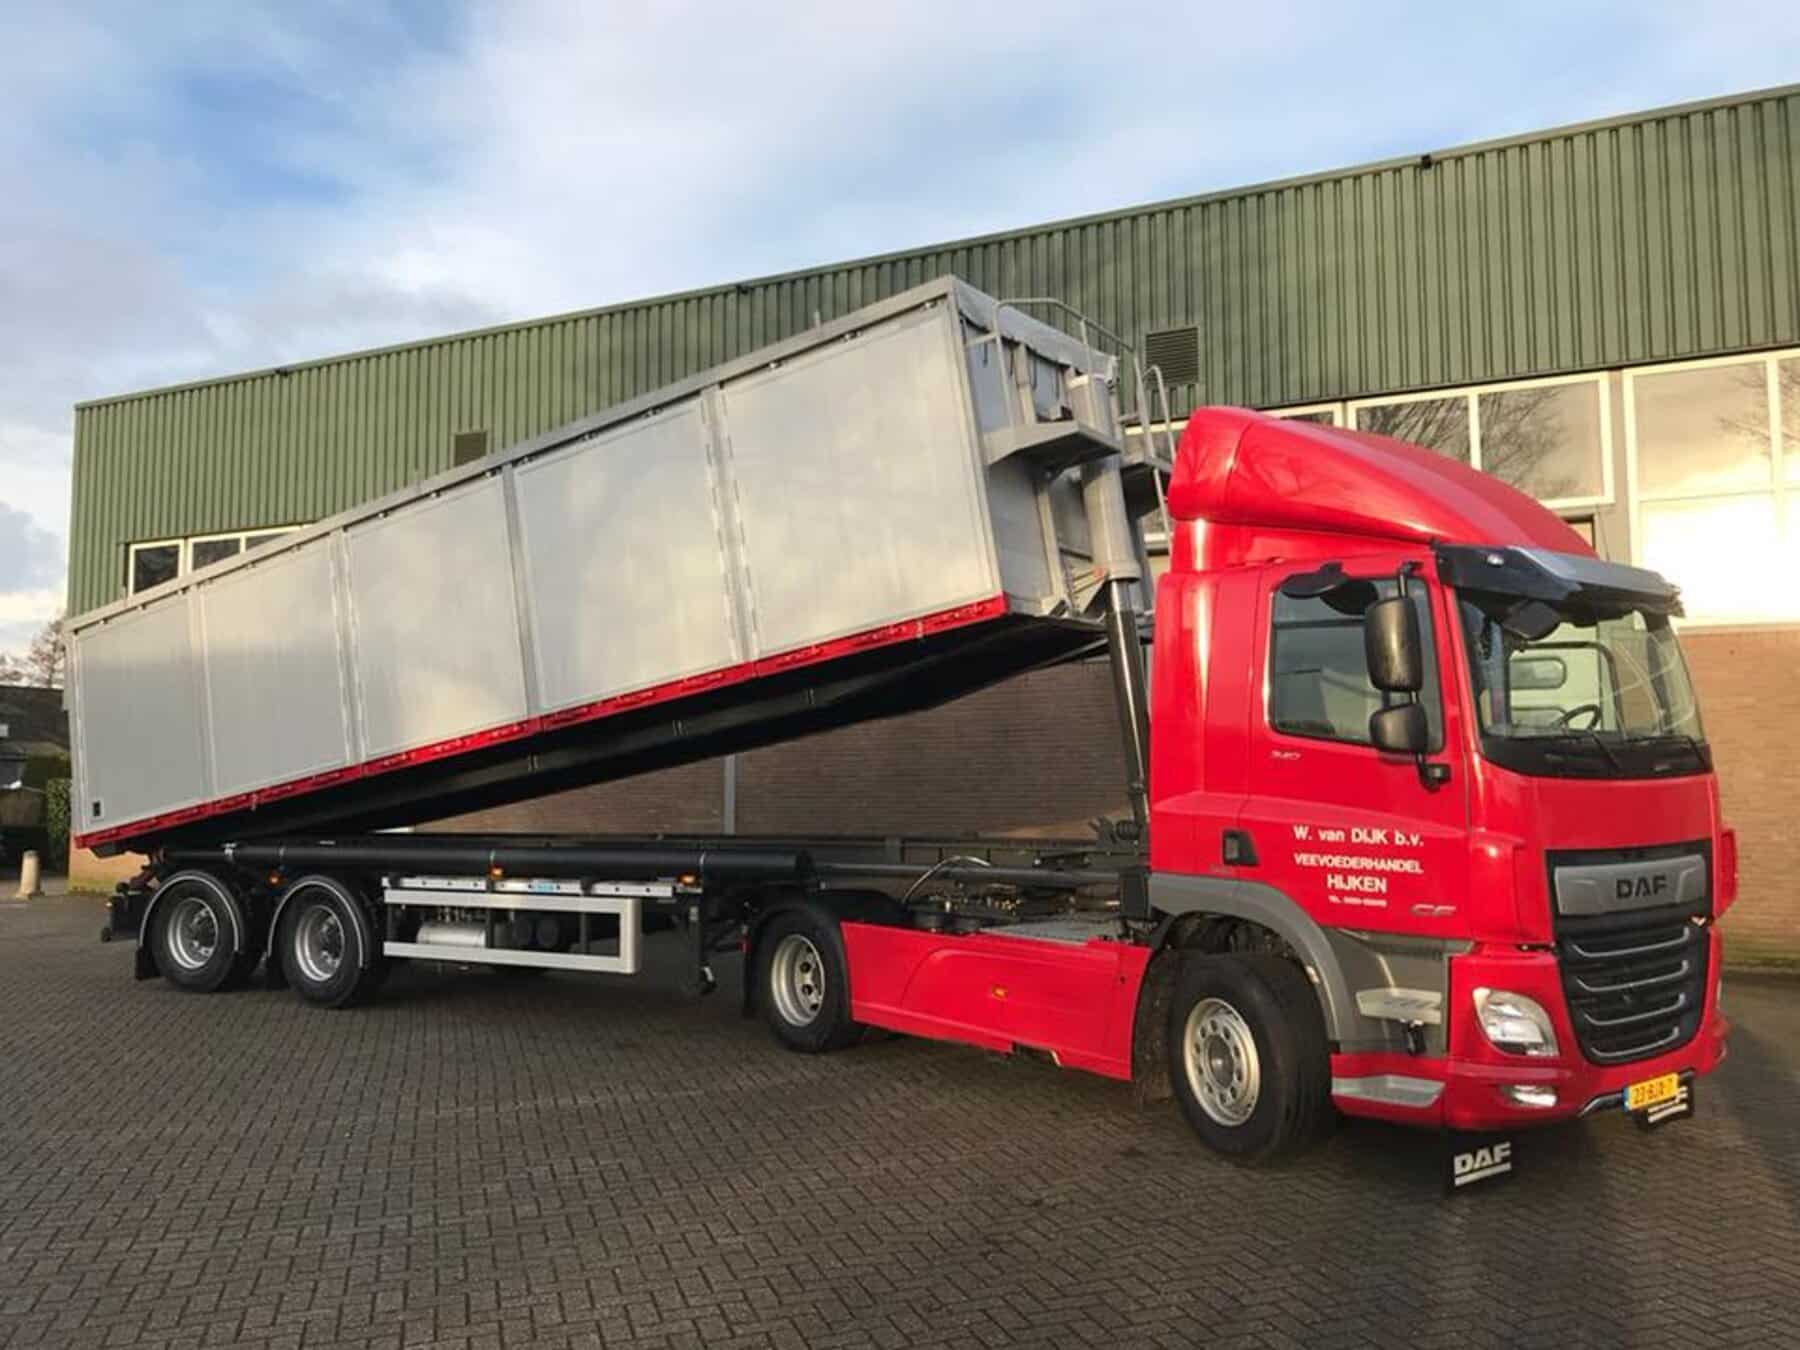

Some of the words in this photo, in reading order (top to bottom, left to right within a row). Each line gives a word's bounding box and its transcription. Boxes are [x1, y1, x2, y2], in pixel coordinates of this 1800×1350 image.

[1293, 825, 1312, 841] W.
[1318, 829, 1345, 842] van
[1351, 827, 1388, 845] DIJK
[1395, 830, 1424, 847] b.v.
[1294, 852, 1424, 874] VEEVOEDERHANDEL
[1327, 873, 1387, 894] HIJKEN
[1616, 874, 1667, 900] DAF
[1454, 1141, 1511, 1176] DAF
